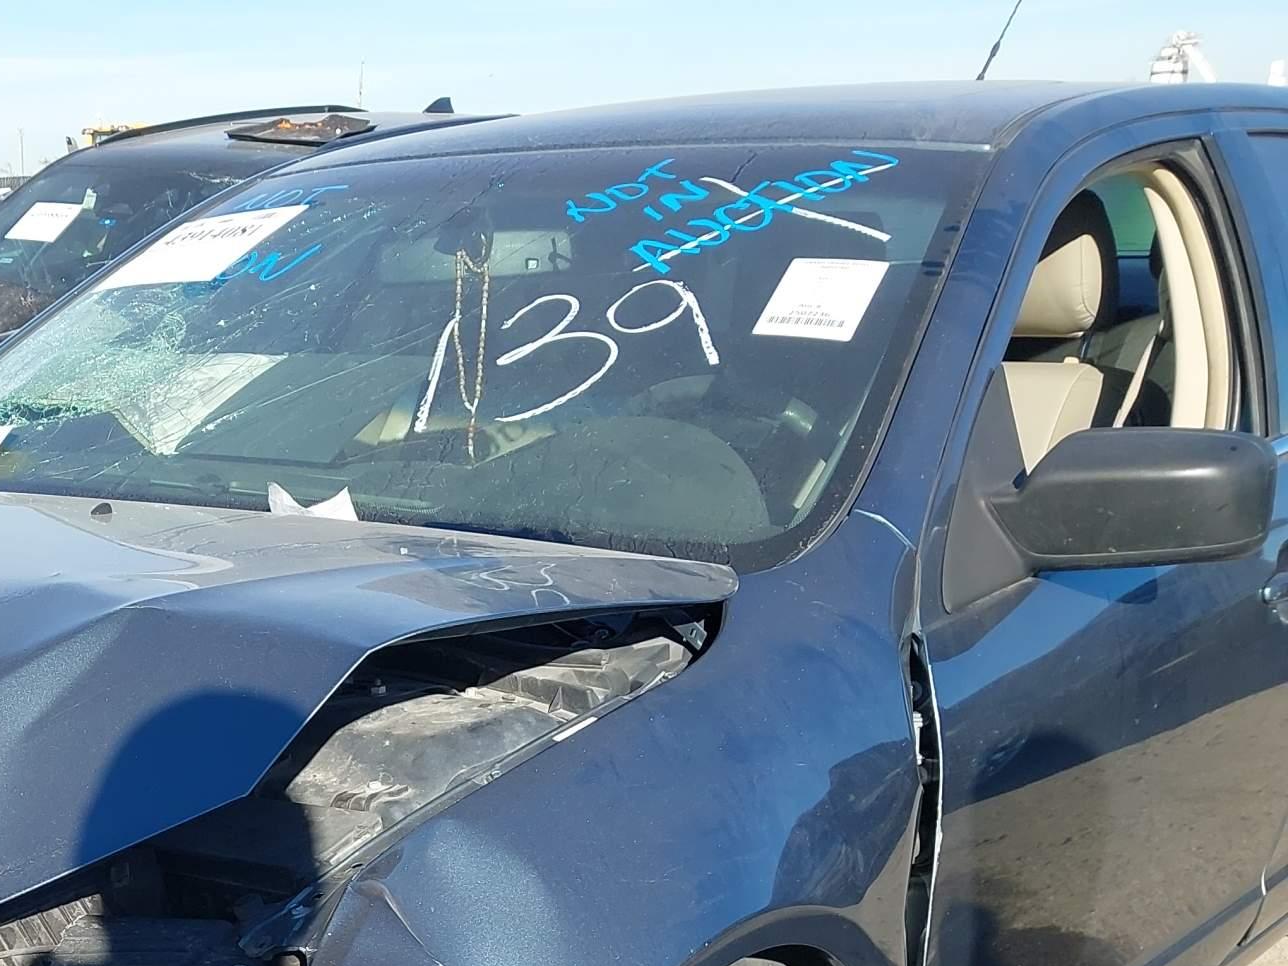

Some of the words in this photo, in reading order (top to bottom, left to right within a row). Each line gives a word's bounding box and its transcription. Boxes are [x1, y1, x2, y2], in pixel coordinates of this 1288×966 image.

[567, 158, 676, 223] NOT
[630, 150, 899, 275] AUCTION
[643, 179, 710, 221] IN
[414, 279, 720, 433] 139
